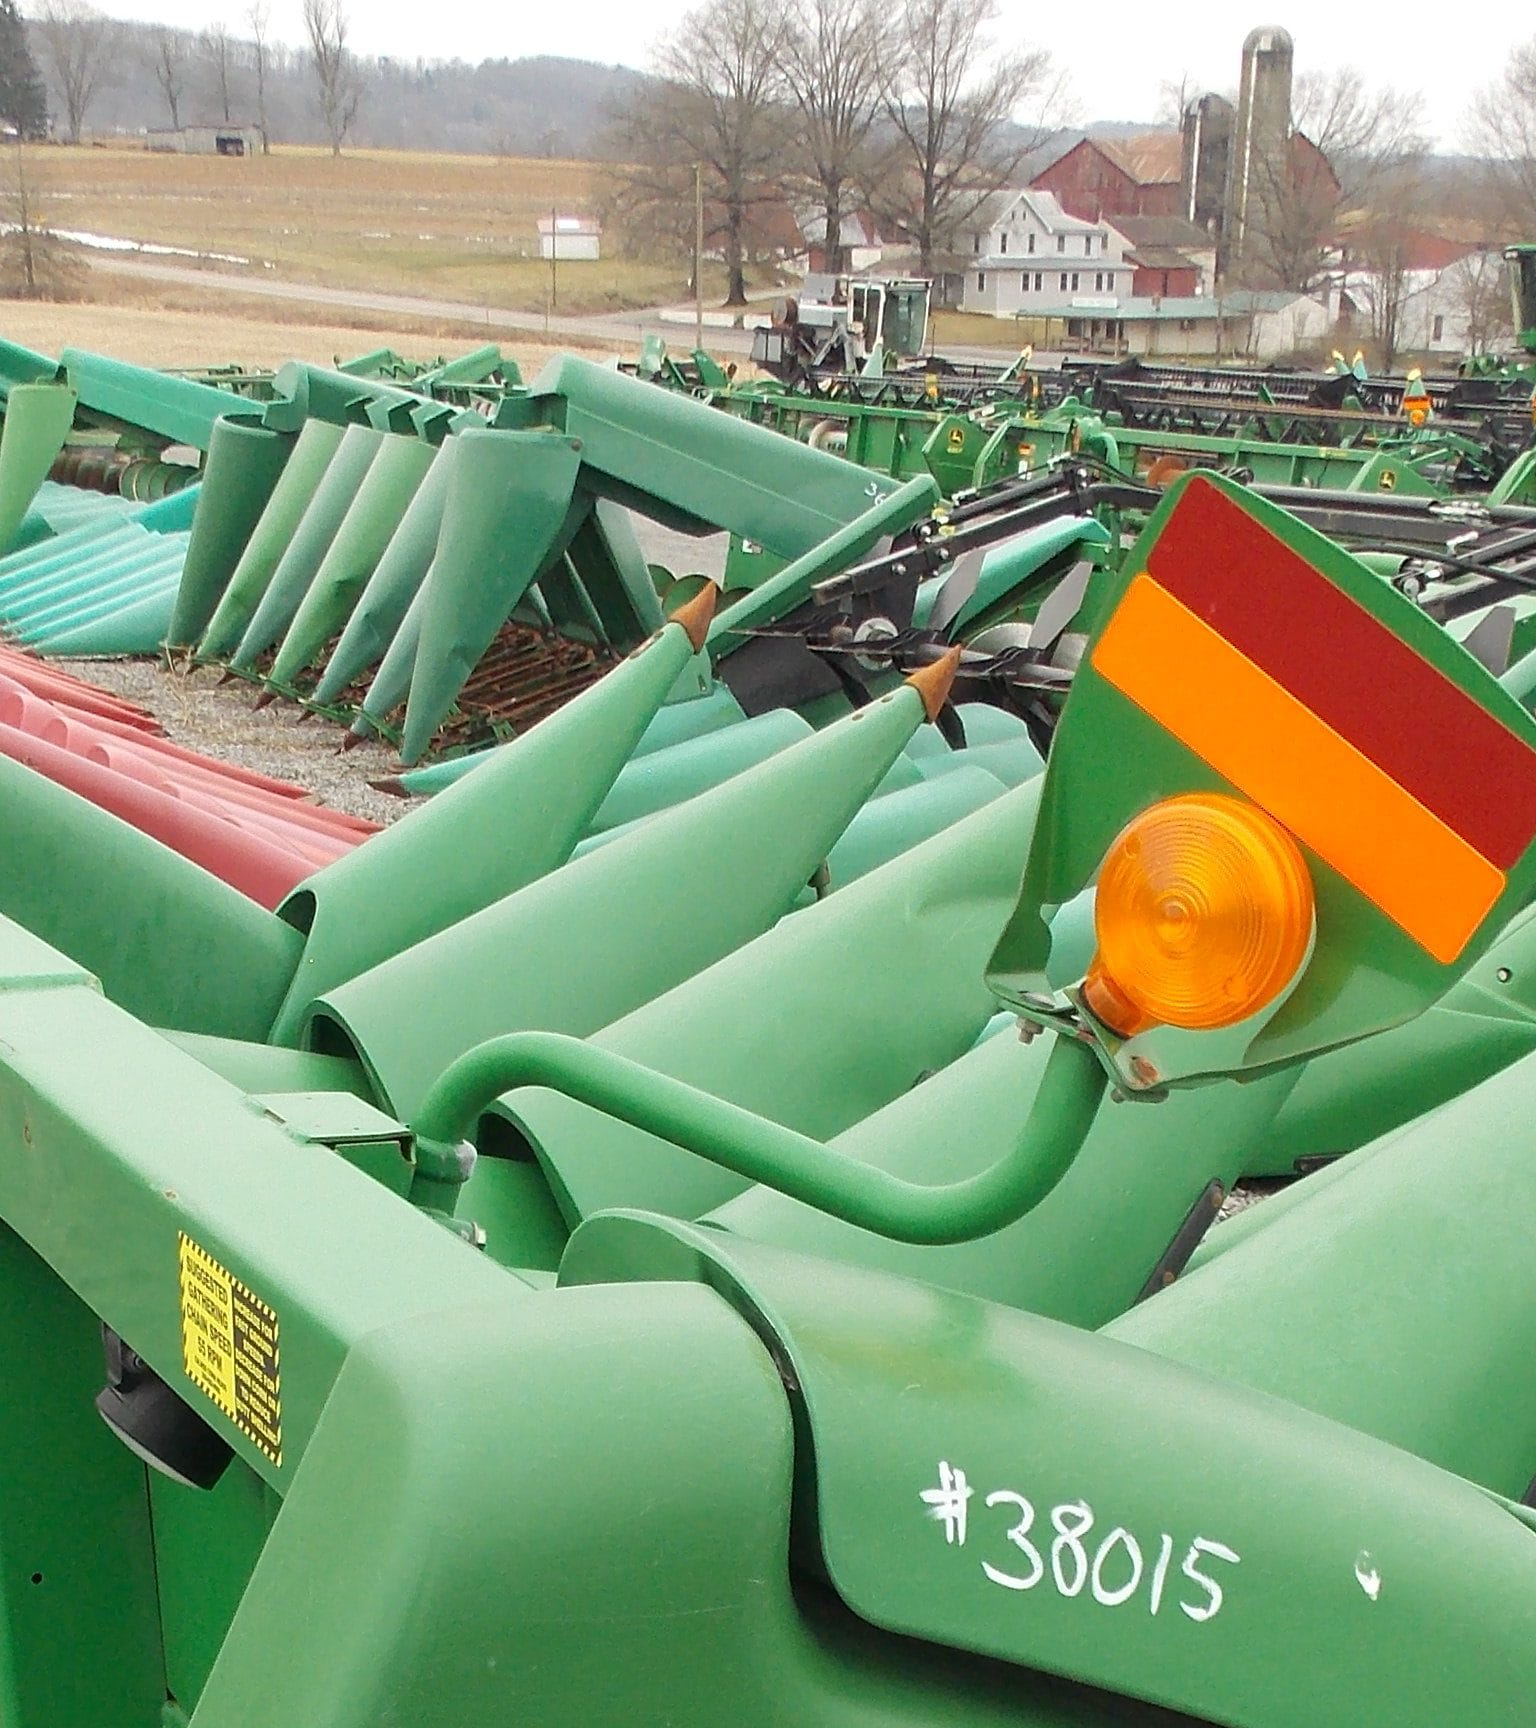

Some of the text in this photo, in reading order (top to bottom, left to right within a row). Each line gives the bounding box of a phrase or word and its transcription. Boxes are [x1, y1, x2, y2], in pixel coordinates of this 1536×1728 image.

[186, 1253, 227, 1307] SUGGESTED
[187, 1278, 228, 1331] GATHERING
[186, 1300, 232, 1359] CHAIN SPEED
[197, 1333, 222, 1374] 55 RPM
[260, 1319, 273, 1343] FOR
[263, 1372, 275, 1395] FOR
[920, 1460, 1241, 1622] #38015
